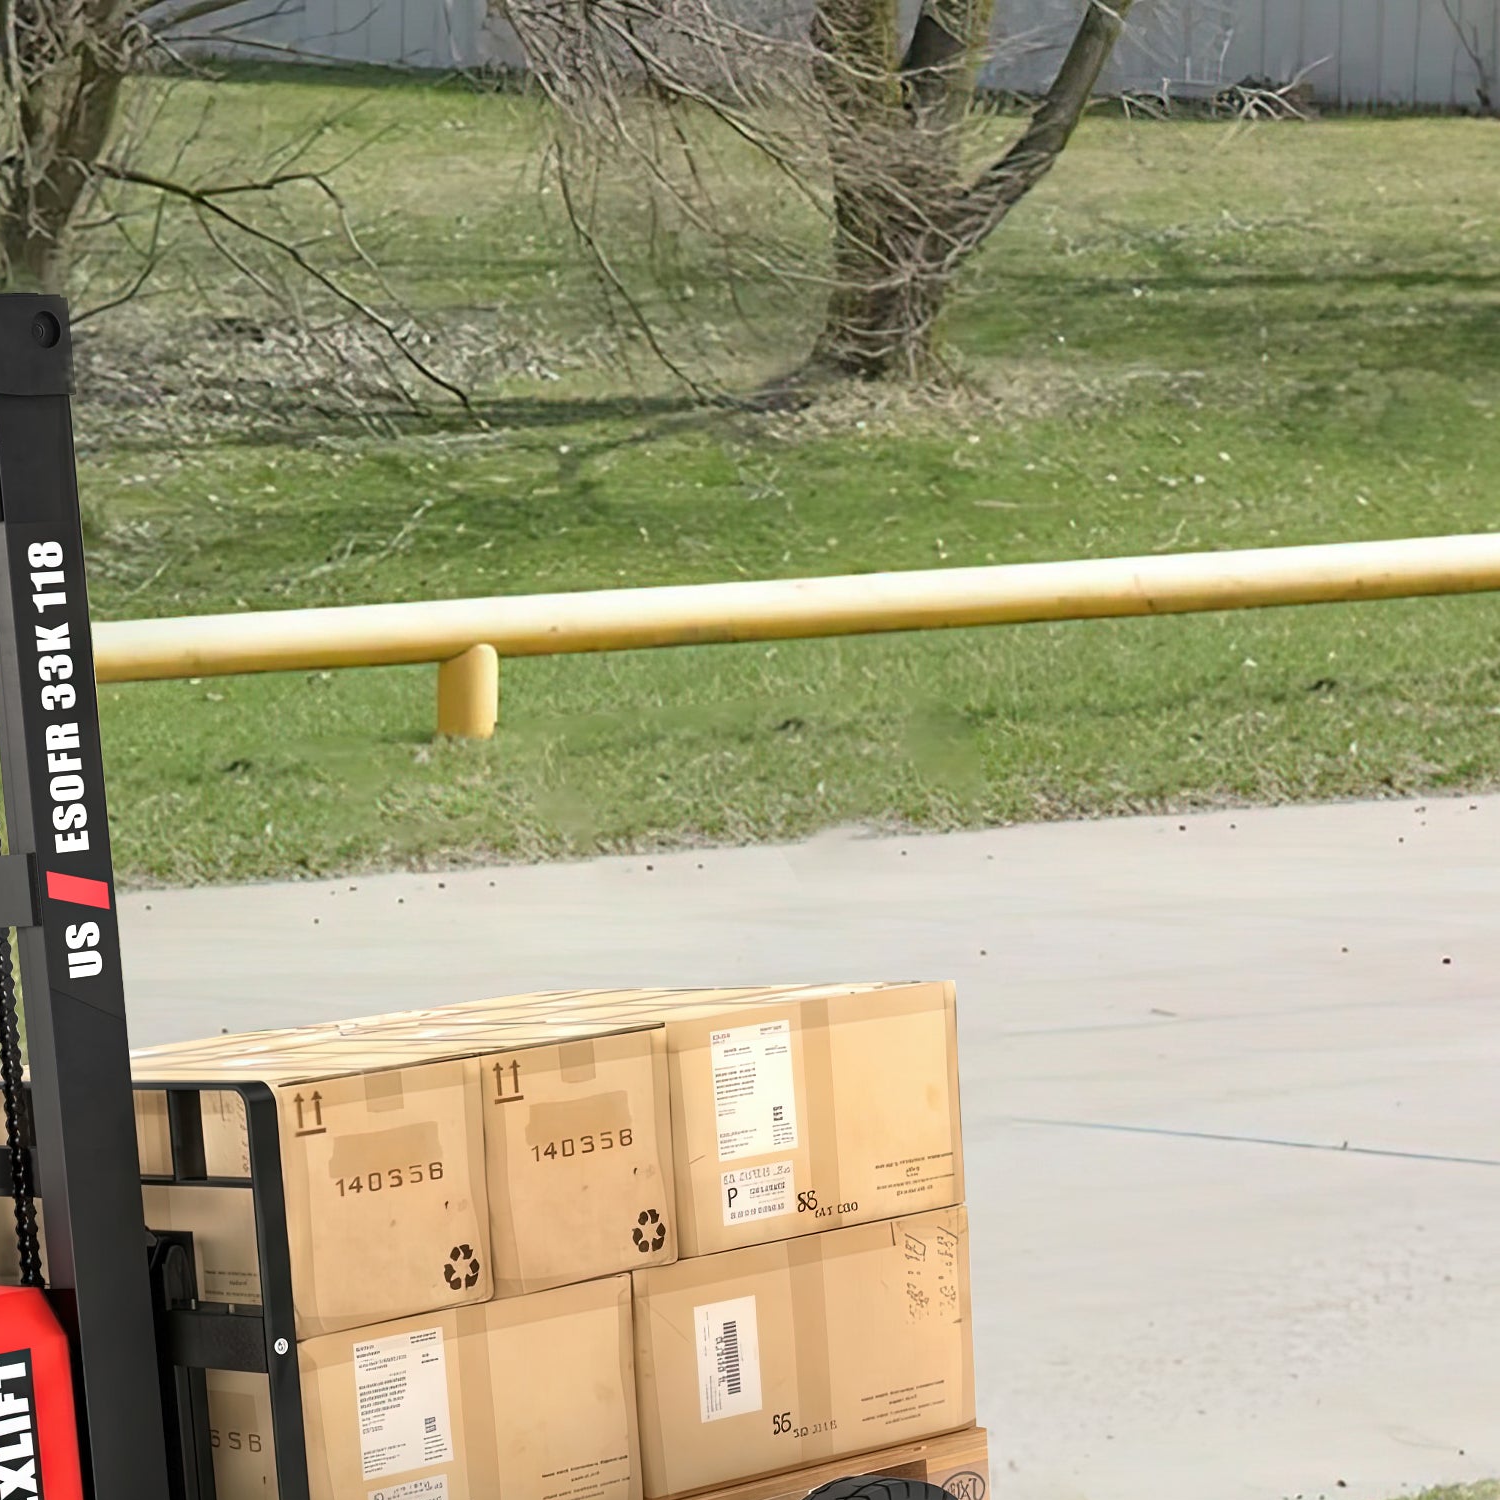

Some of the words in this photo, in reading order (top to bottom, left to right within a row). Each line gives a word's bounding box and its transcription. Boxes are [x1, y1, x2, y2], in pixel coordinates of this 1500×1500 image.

[27, 541, 68, 614] 118
[34, 621, 77, 711] 33K
[45, 722, 91, 854] ESOFR
[64, 921, 103, 979] US
[727, 1187, 739, 1209] P
